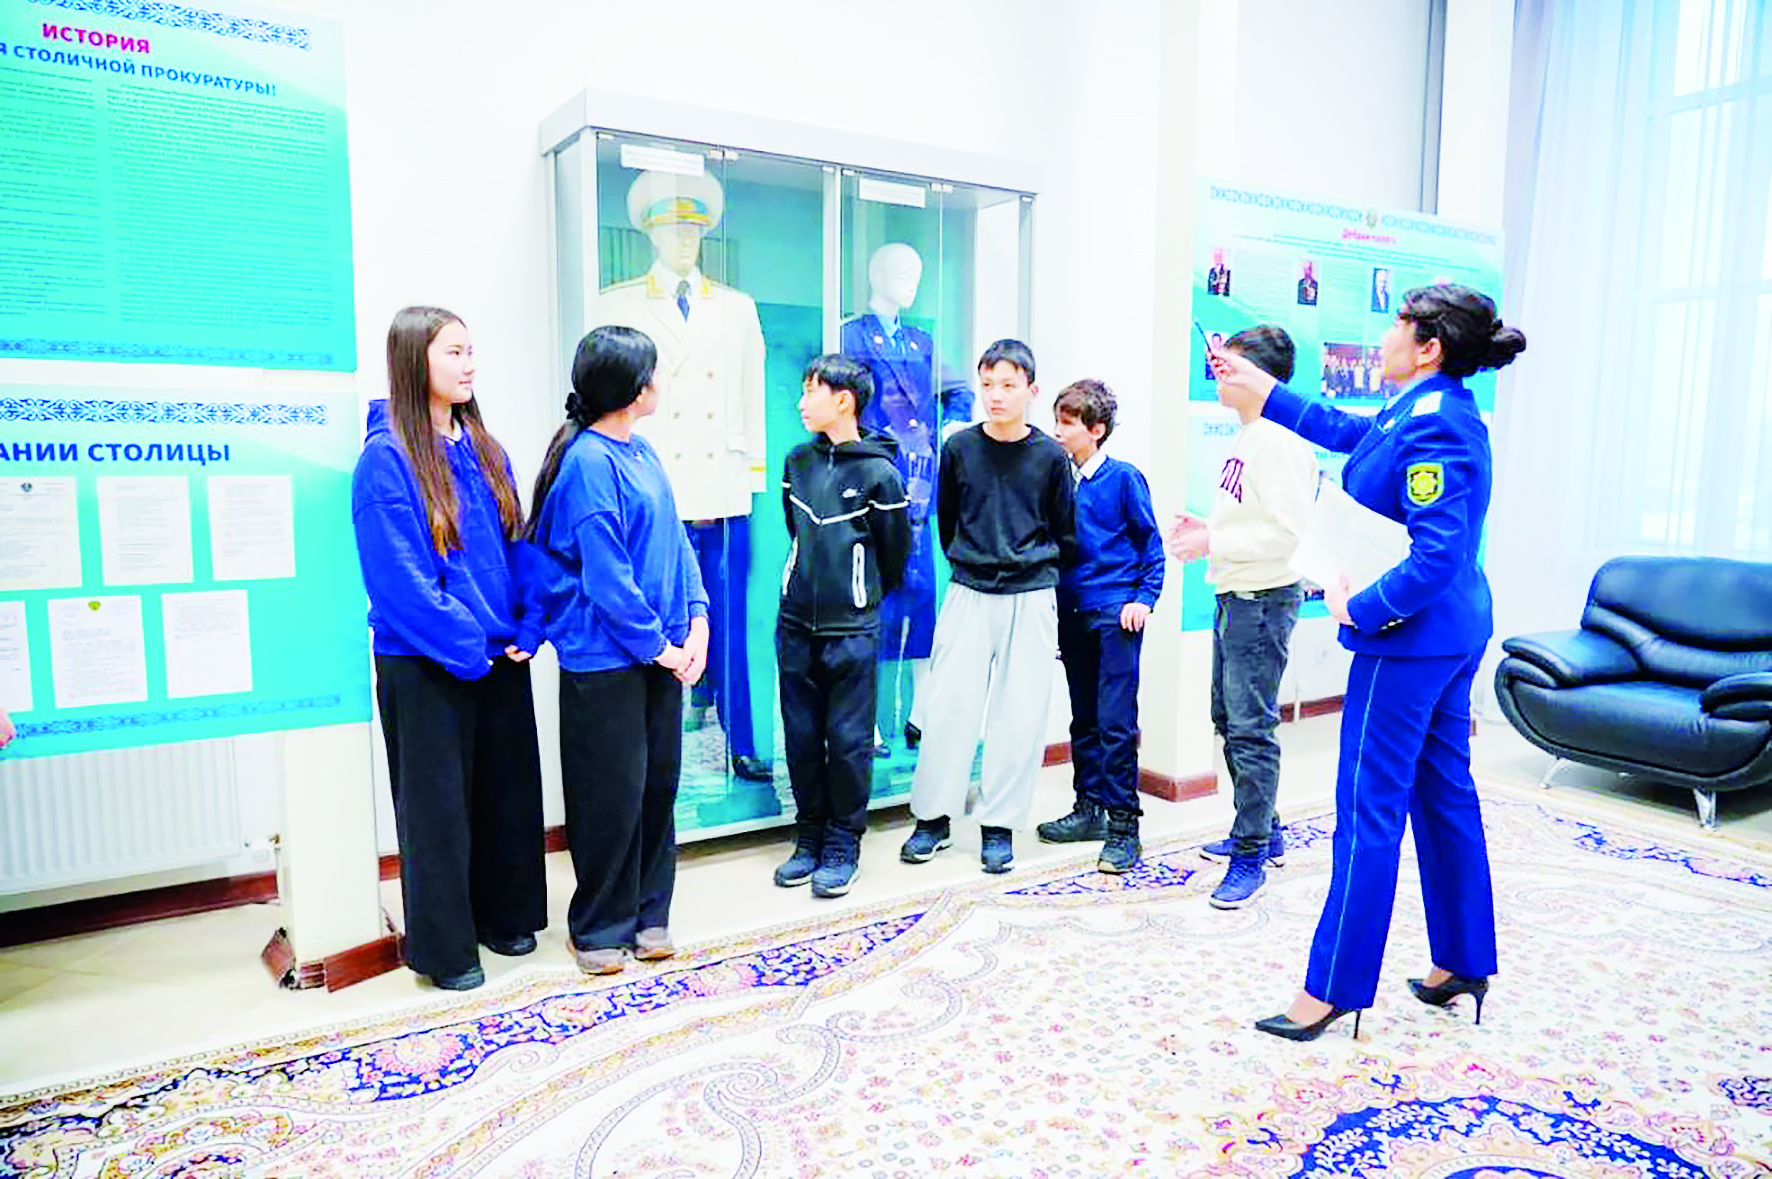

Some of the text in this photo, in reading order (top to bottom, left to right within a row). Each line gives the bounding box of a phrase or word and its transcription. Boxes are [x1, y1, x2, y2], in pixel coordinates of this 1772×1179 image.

[42, 23, 150, 53] ИСТОРИЯ
[14, 45, 136, 75] СТОЛИЧНОЙ
[141, 64, 276, 96] ПРОКУРАТУРЫ!
[87, 443, 231, 466] СТОЛИЦЫ
